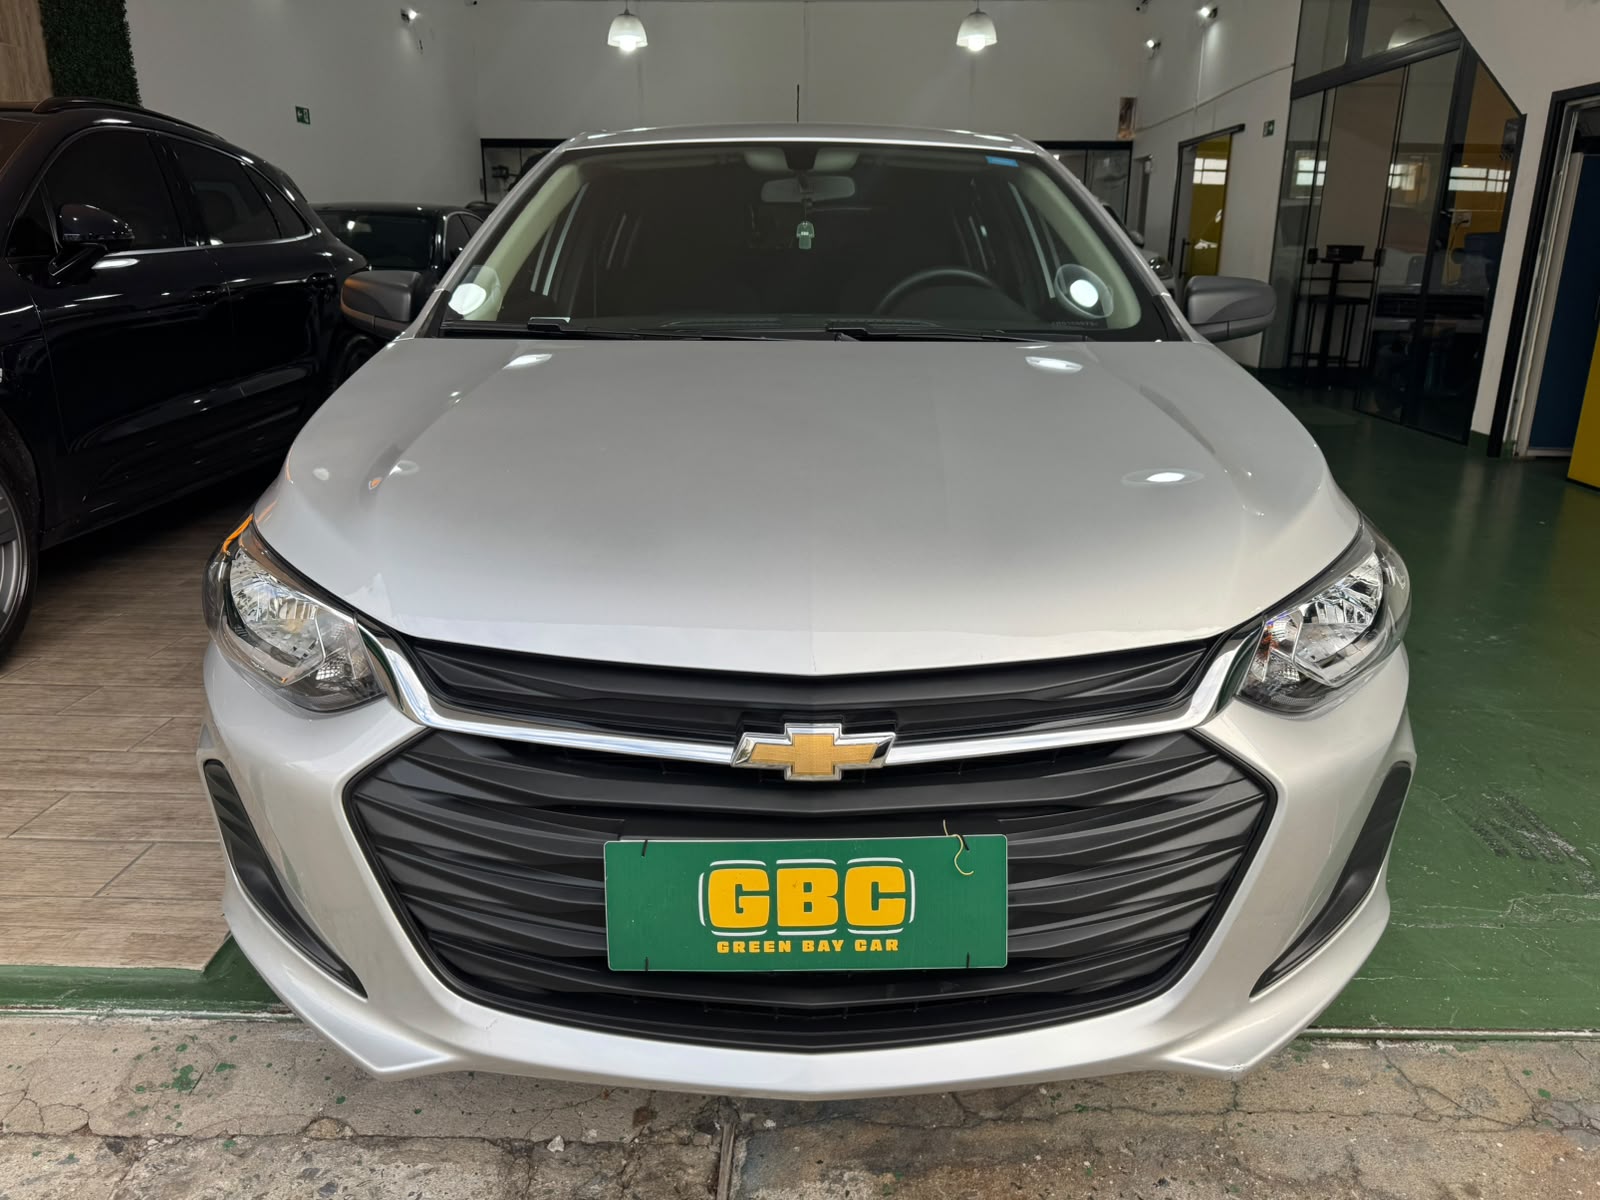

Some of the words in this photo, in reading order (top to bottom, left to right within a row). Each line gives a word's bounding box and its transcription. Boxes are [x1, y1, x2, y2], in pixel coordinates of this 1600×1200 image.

[708, 866, 907, 929] GBC
[716, 940, 792, 954] GREEN
[802, 940, 844, 953] BAY
[854, 939, 899, 952] CAR
